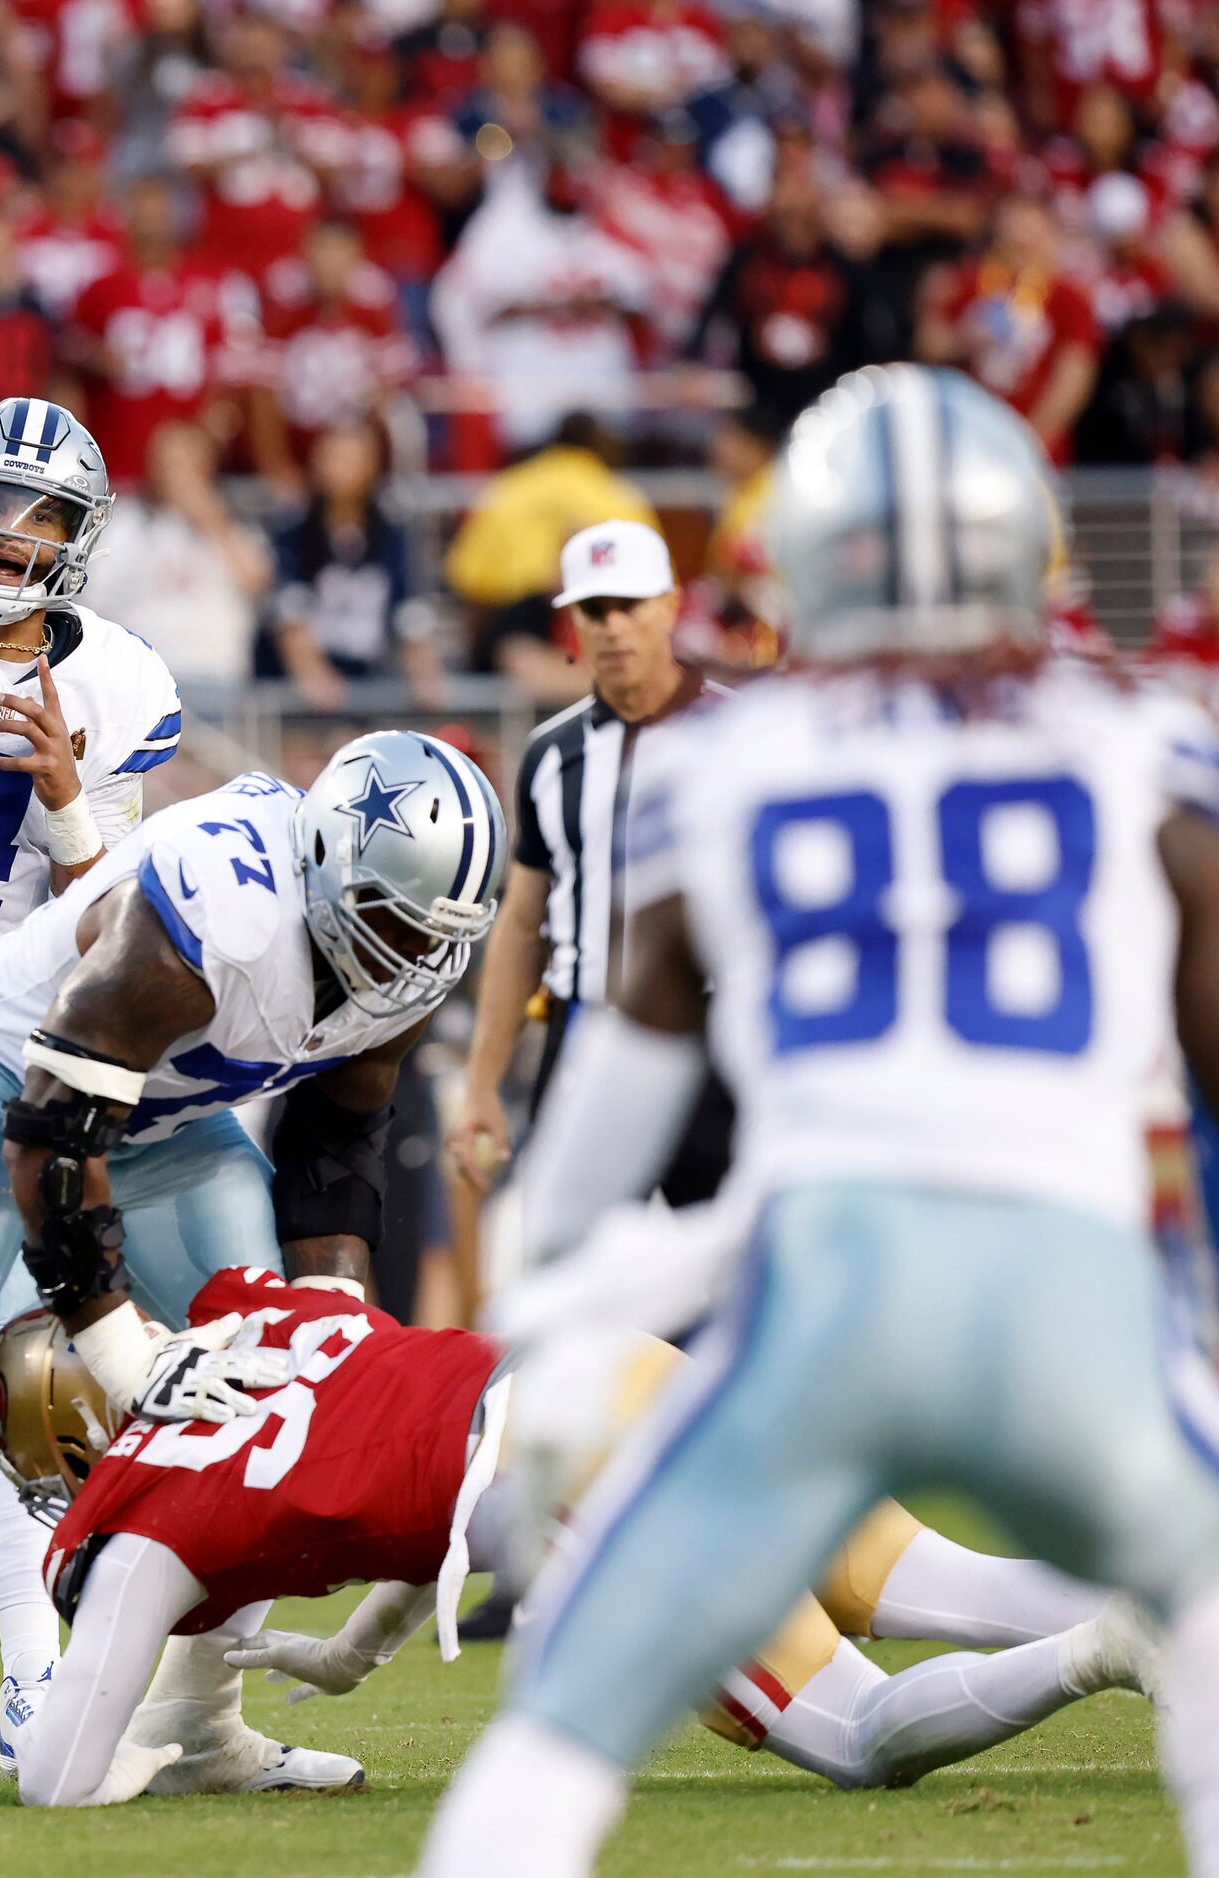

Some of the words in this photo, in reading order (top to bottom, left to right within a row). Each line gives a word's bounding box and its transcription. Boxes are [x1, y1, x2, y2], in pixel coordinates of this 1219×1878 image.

[3, 459, 46, 475] COWBOYS
[196, 818, 277, 896] 77
[750, 772, 1097, 1058] 88
